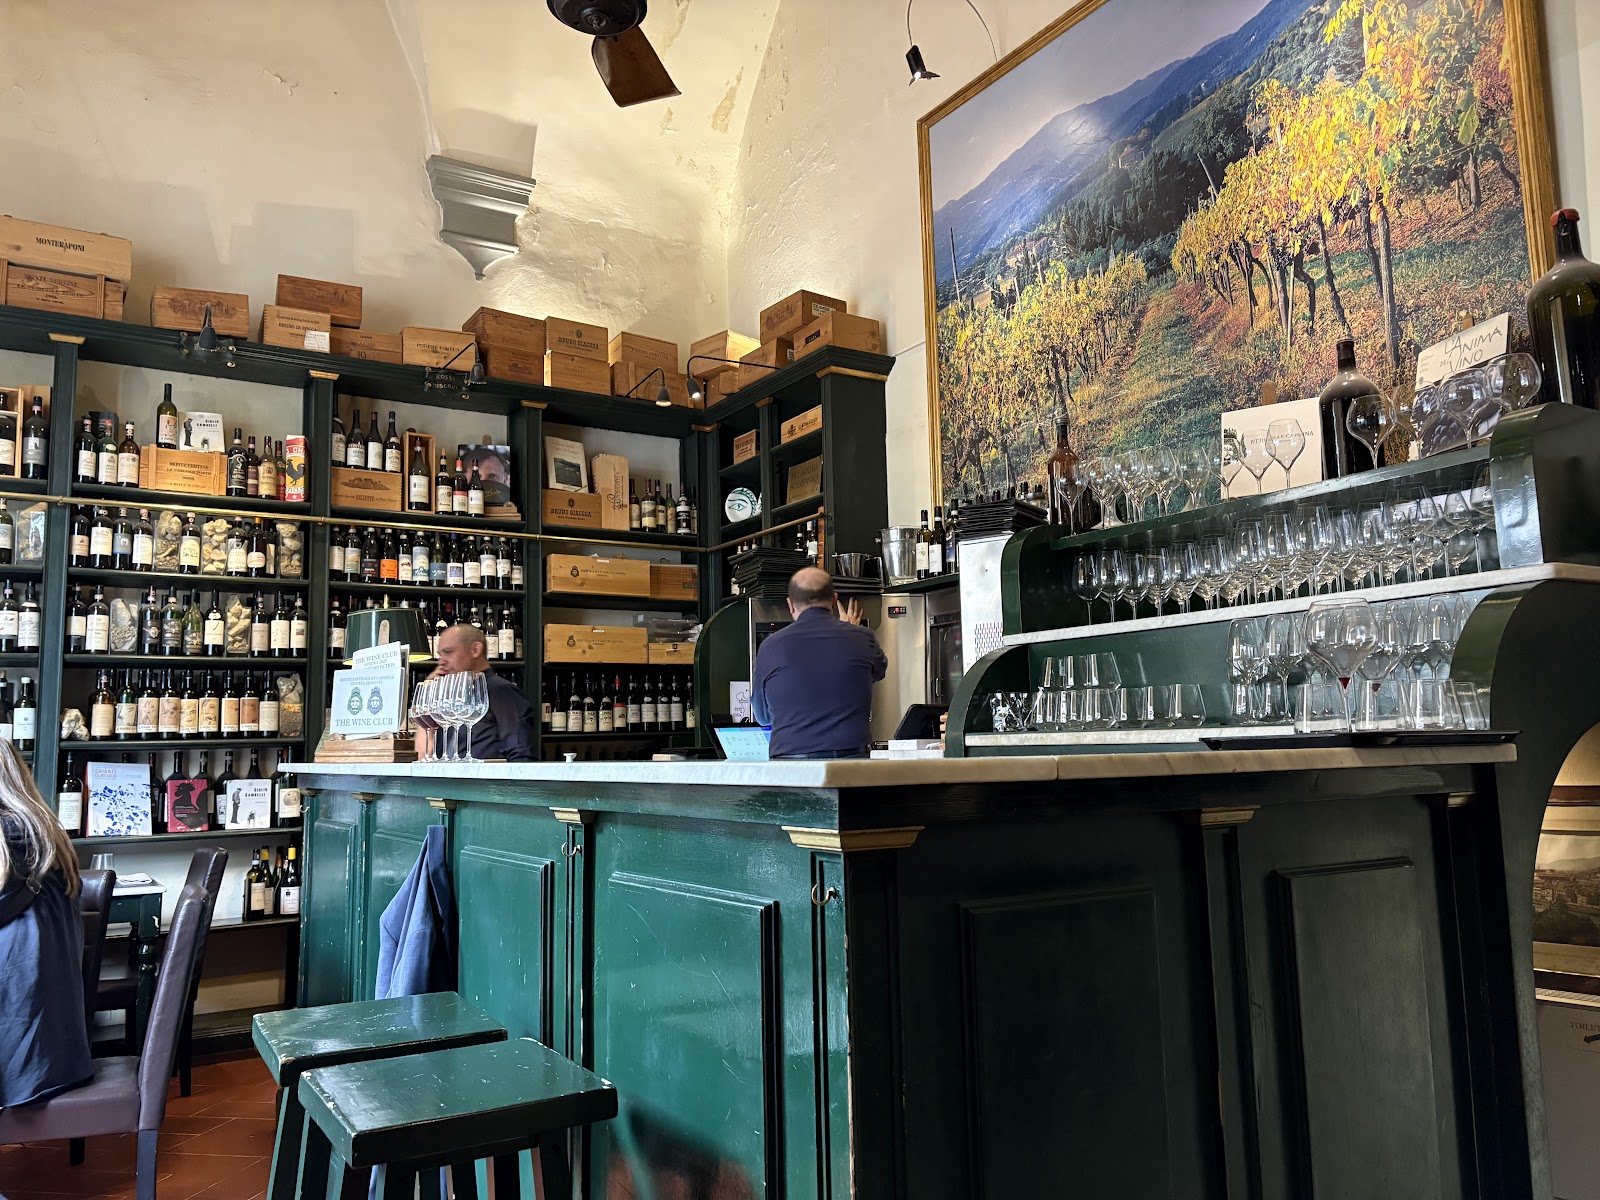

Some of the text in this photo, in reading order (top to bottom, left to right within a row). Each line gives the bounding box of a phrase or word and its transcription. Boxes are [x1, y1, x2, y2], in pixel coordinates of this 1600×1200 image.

[35, 236, 85, 252] MONTERAPONI
[1450, 349, 1484, 374] VINO
[550, 507, 569, 516] BRUNO
[366, 653, 381, 662] WINE
[382, 650, 398, 658] CLUB
[335, 717, 393, 727] THE WINE CLUB
